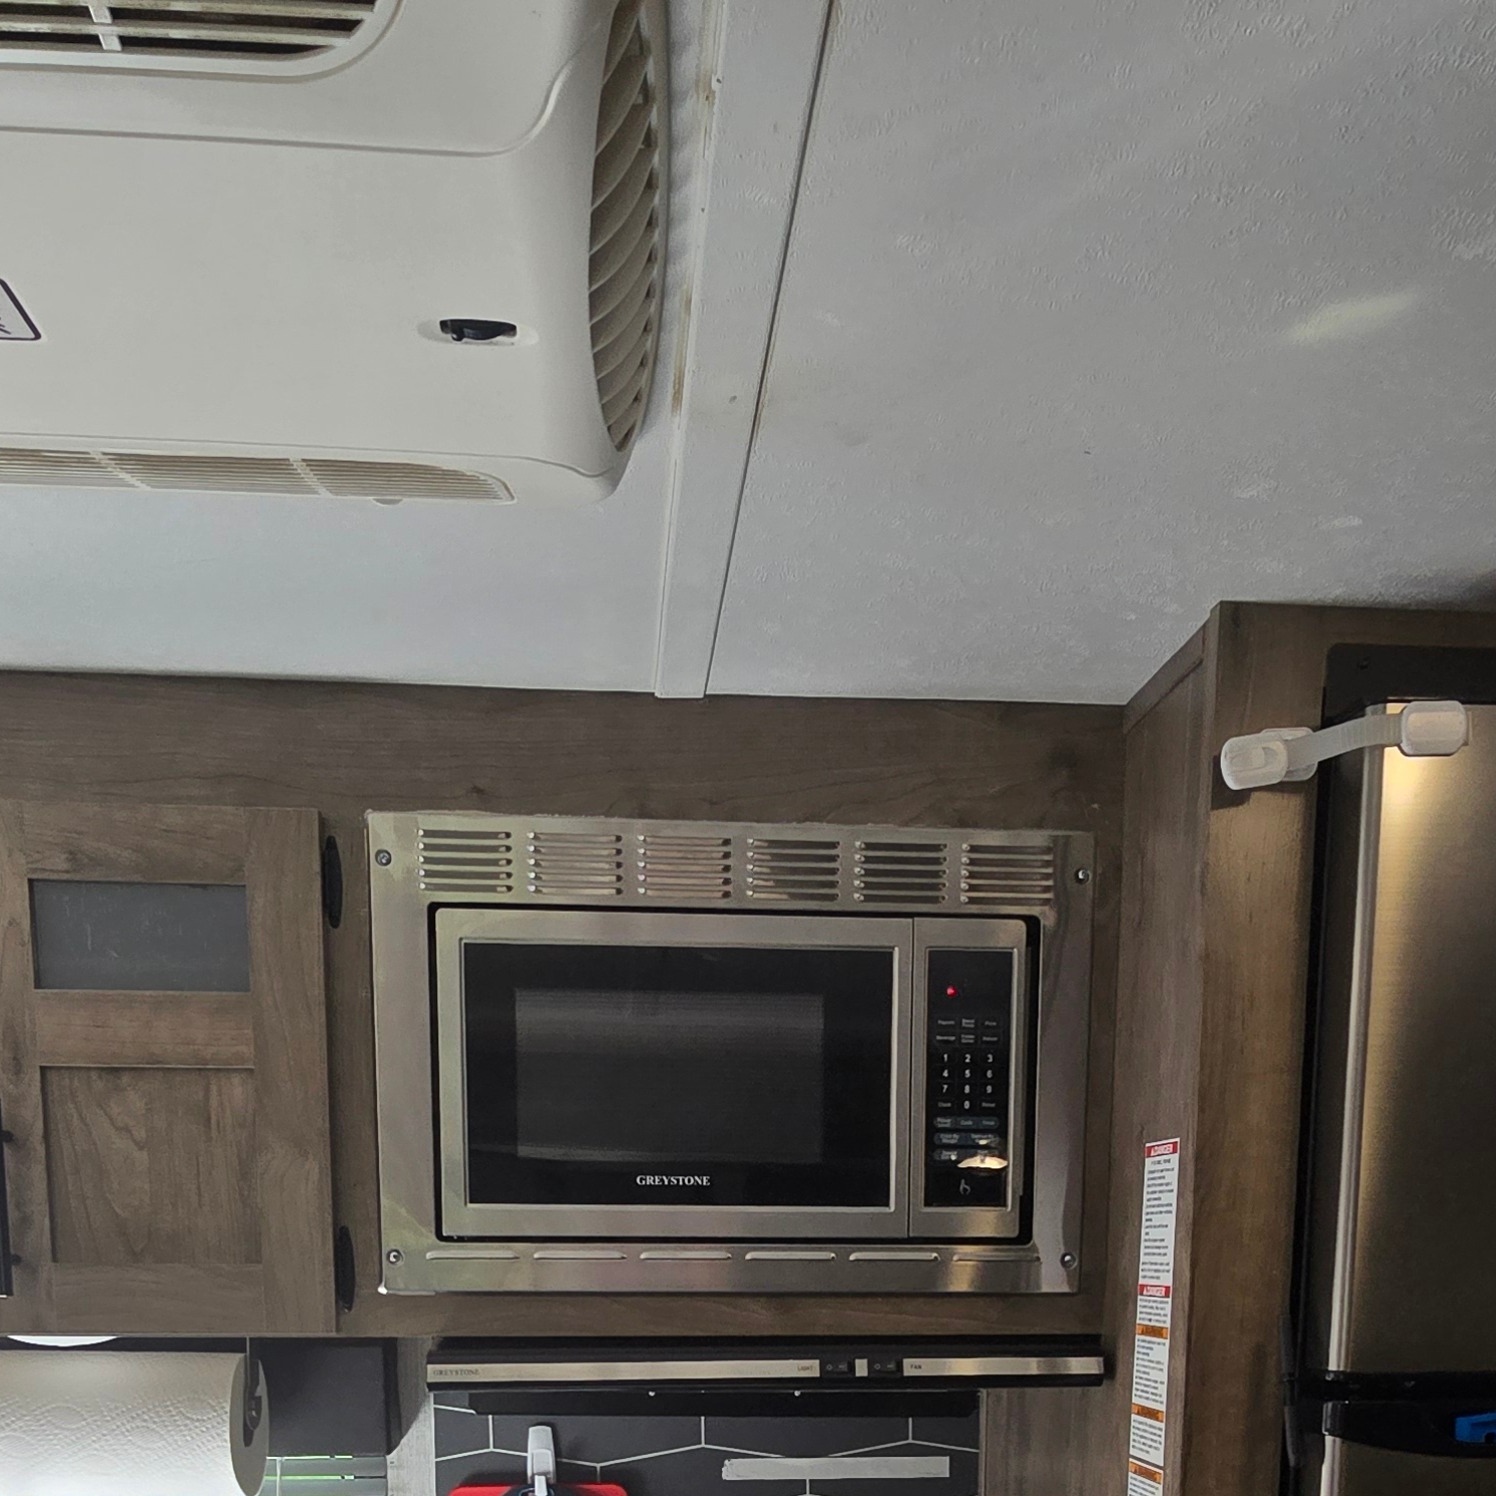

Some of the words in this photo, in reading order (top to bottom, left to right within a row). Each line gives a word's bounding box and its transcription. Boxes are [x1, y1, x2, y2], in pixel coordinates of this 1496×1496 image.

[943, 1053, 948, 1062] 1
[965, 1053, 971, 1063] 2
[987, 1053, 993, 1063] 3
[942, 1068, 949, 1078] 4
[964, 1068, 971, 1078] 5
[986, 1069, 993, 1078] 6
[942, 1084, 949, 1093] 7
[964, 1084, 970, 1094] 8
[986, 1084, 992, 1094] 9
[964, 1100, 970, 1109] 0
[635, 1174, 711, 1187] GREYSTONE
[433, 1368, 480, 1377] GREYSTONE
